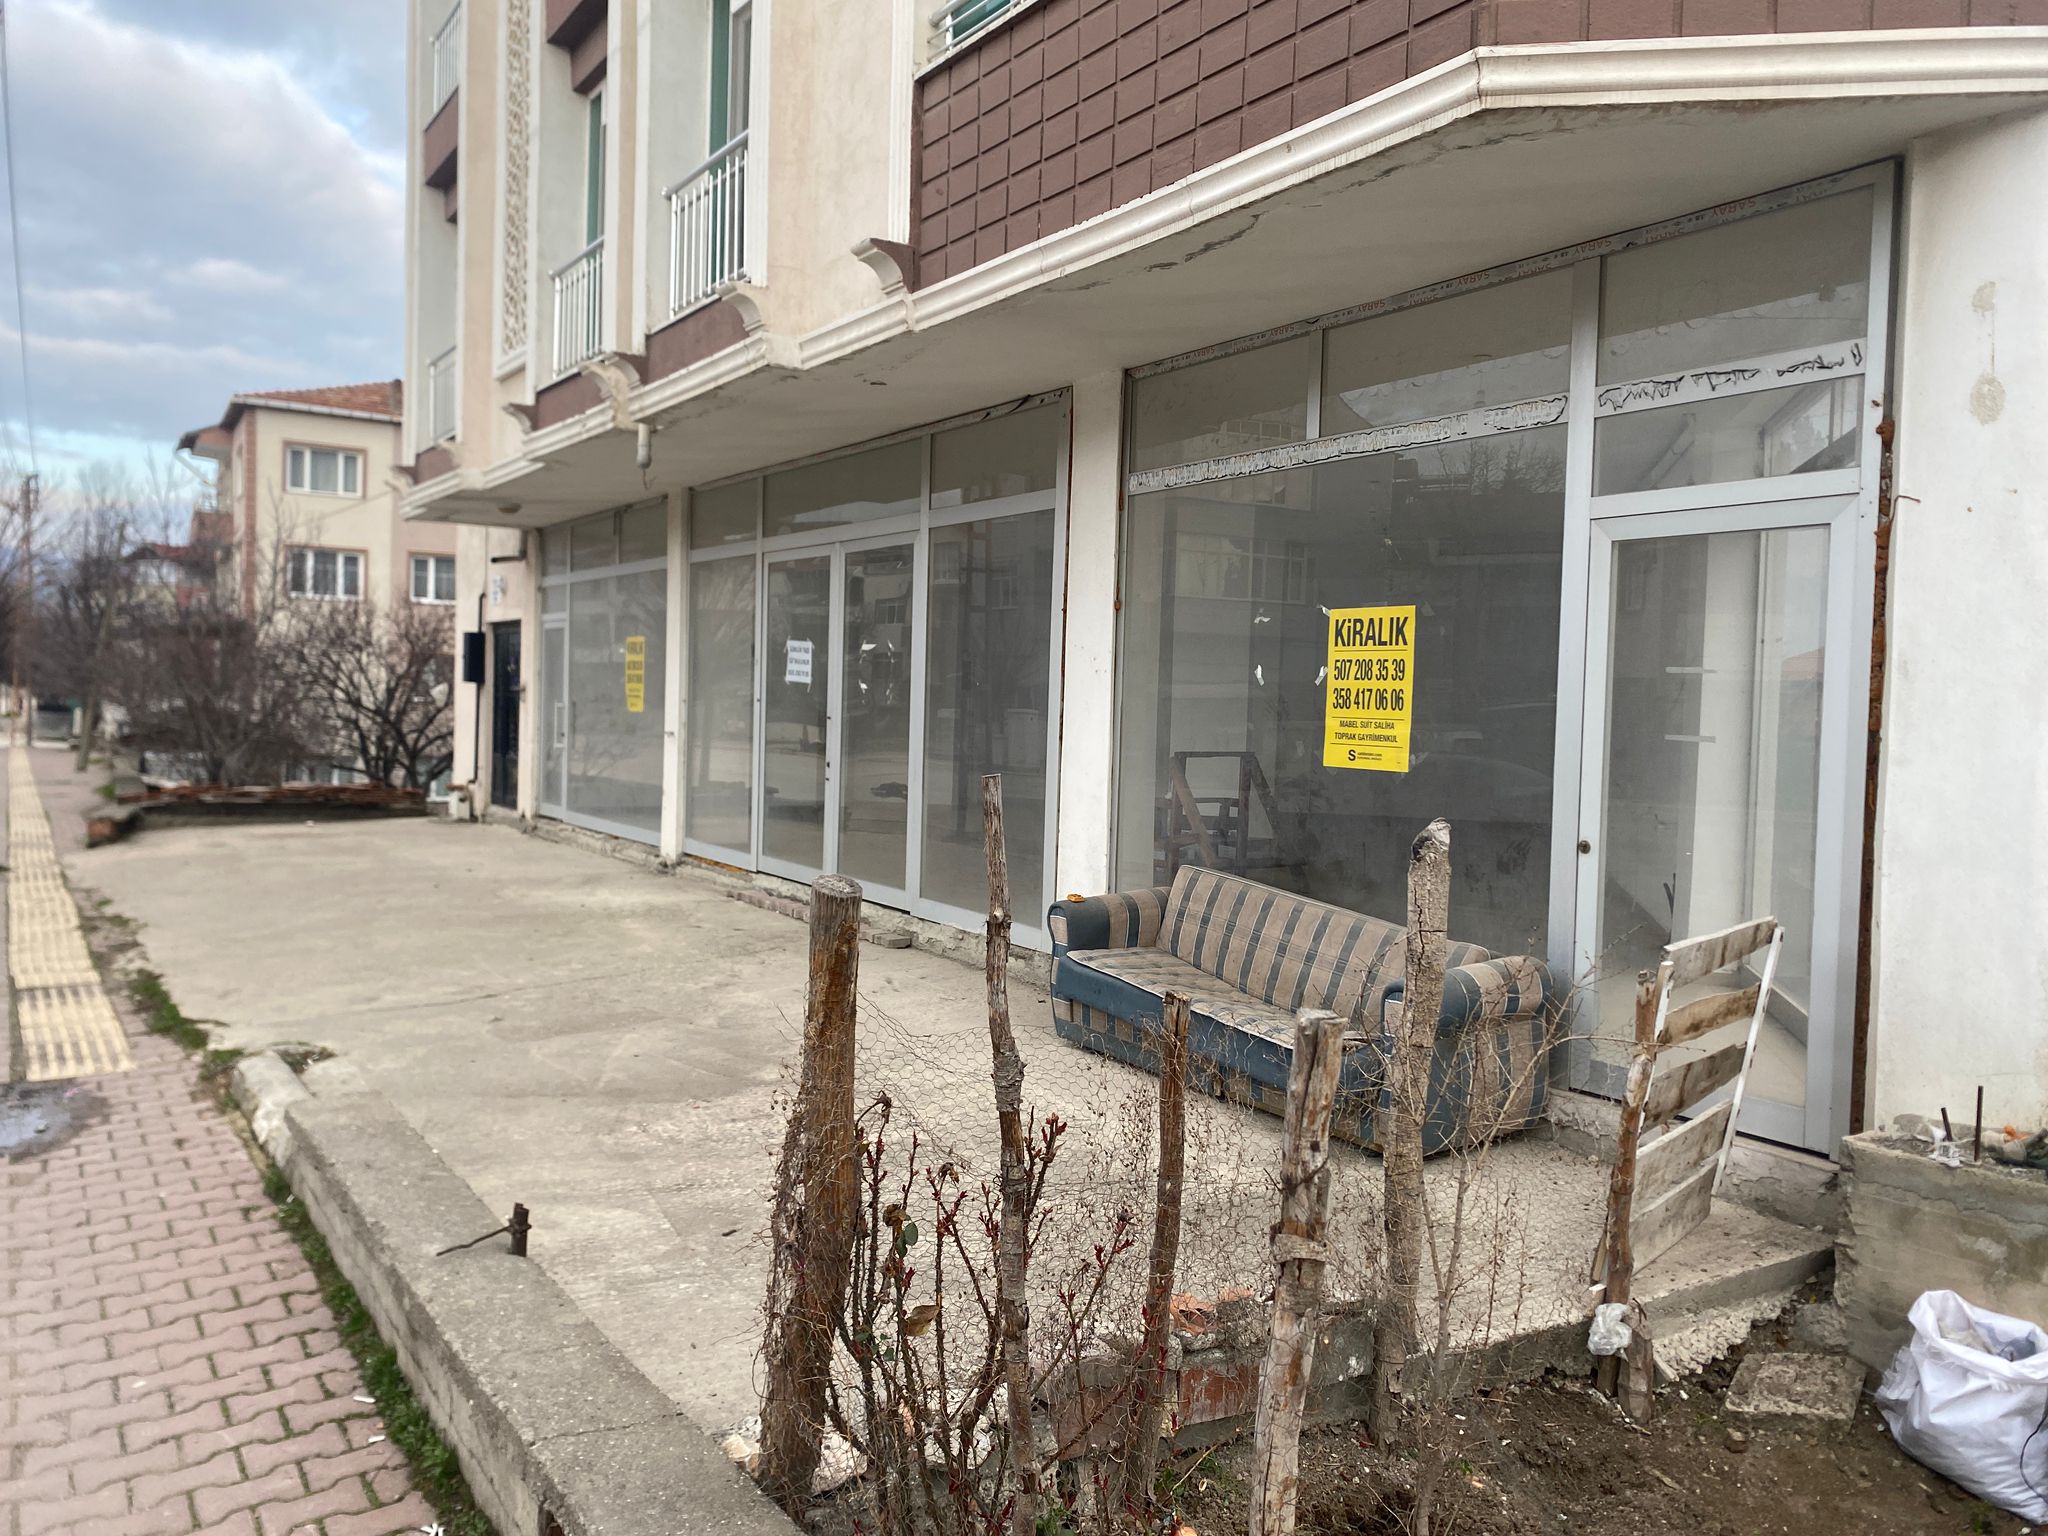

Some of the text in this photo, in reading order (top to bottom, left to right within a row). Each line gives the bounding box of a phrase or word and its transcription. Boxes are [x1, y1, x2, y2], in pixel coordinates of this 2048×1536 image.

[1711, 200, 1756, 217] SARAY
[1574, 239, 1612, 255] SARAY
[1457, 271, 1490, 287] SARAY
[1358, 299, 1386, 313] SARAY
[1269, 325, 1295, 337] SARAY
[1334, 659, 1405, 681] 507 208 35 39
[1333, 688, 1404, 711] 358 417 06 06
[1339, 720, 1358, 729] MABEL
[1334, 732, 1356, 741] TOPRAK
